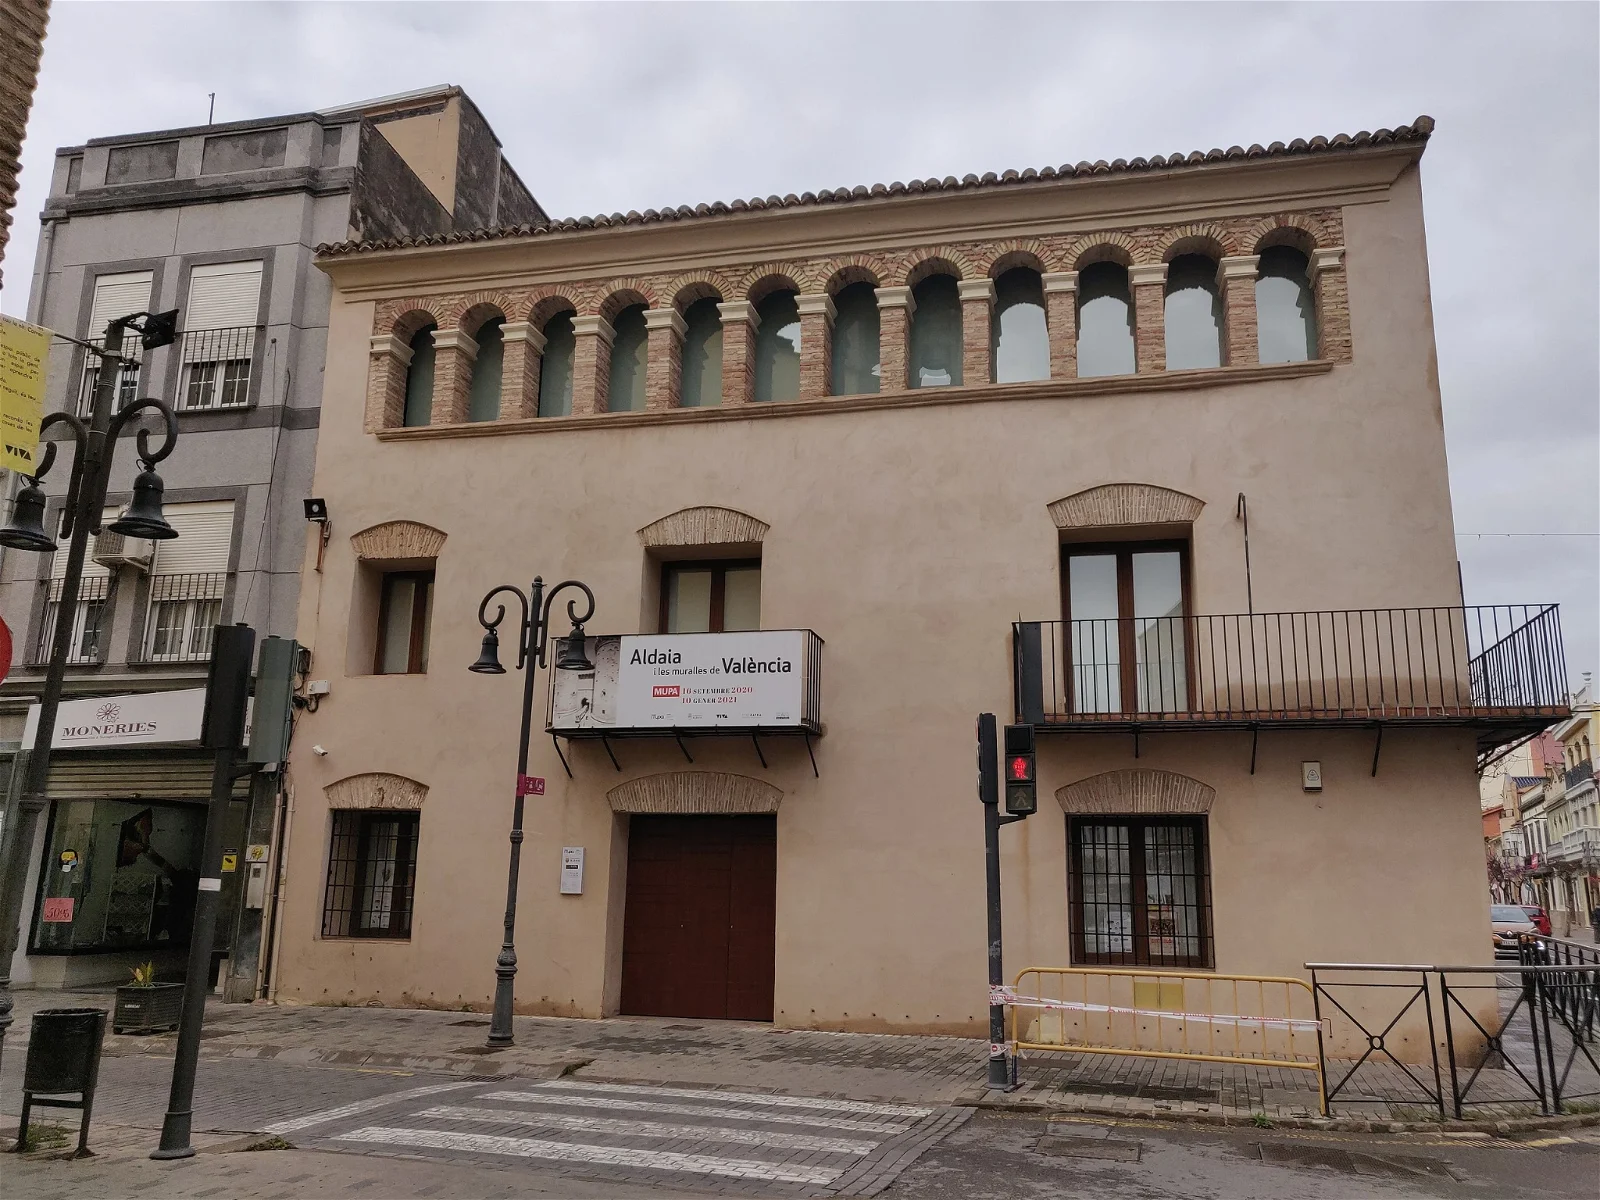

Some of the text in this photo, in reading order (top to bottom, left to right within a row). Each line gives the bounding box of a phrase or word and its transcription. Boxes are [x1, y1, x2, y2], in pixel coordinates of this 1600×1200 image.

[5, 444, 32, 461] VIVA
[630, 649, 682, 665] Aldaia
[653, 665, 720, 676] i les muralles de
[721, 657, 792, 674] València
[653, 687, 679, 696] MUPA
[682, 687, 692, 695] 16
[731, 686, 753, 694] 2020
[717, 696, 737, 704] 2021
[62, 721, 157, 737] MONERIES
